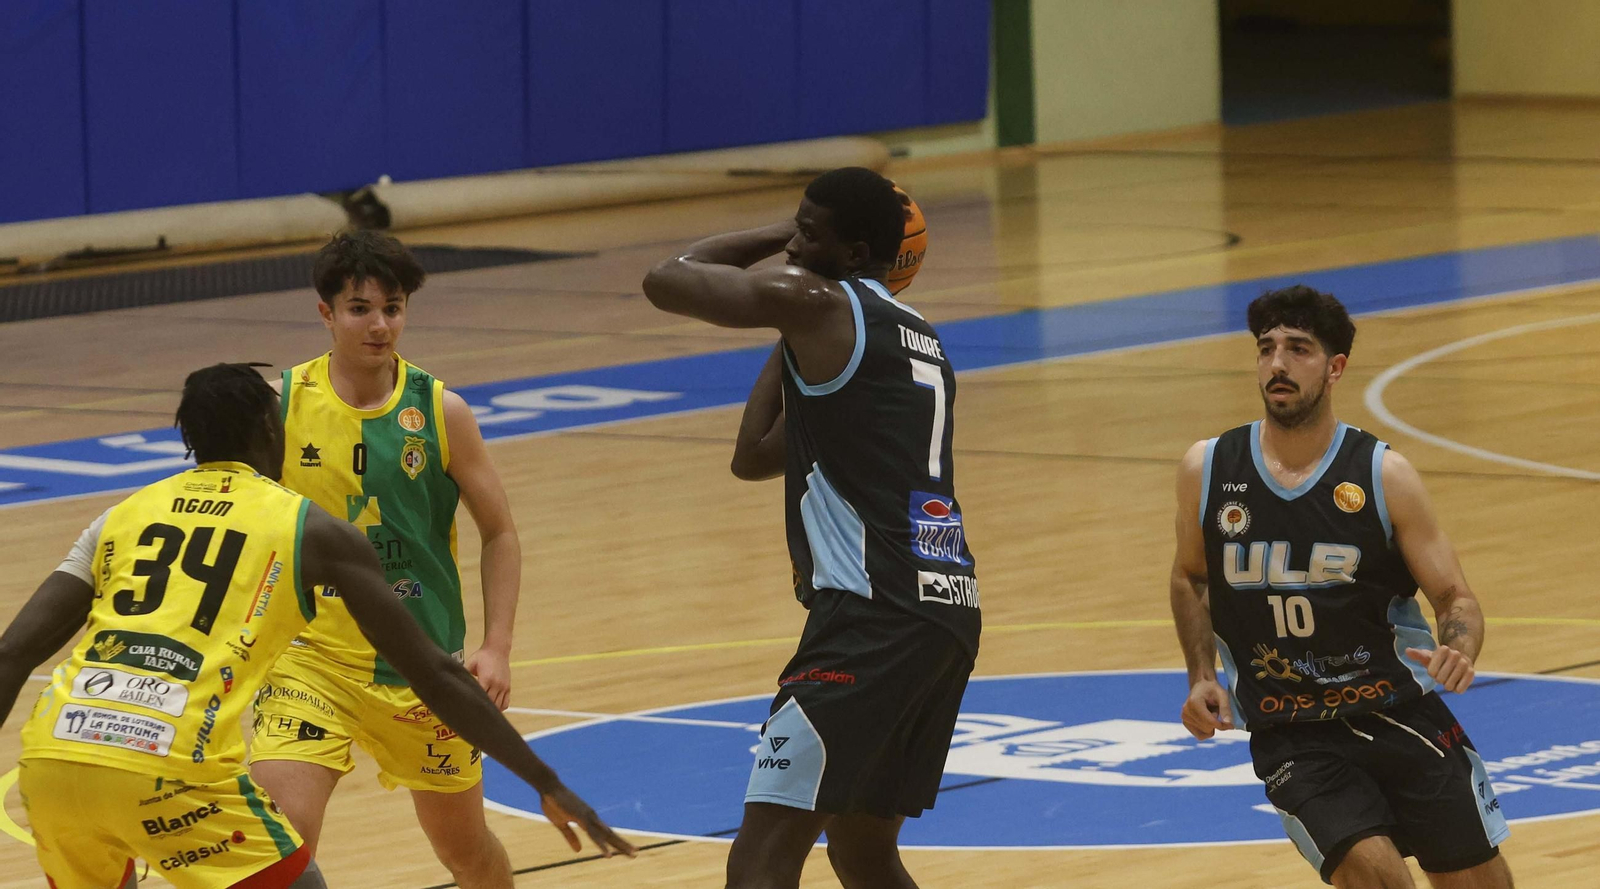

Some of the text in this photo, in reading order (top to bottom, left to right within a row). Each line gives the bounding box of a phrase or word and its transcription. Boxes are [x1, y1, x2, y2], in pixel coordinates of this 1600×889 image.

[898, 324, 945, 361] TOURE
[909, 358, 946, 482] 7
[353, 443, 367, 475] 0
[1222, 481, 1248, 493] vive
[112, 522, 248, 636] 34
[1224, 541, 1362, 590] ULB
[1267, 595, 1315, 638] 10
[158, 647, 199, 671] RURAL
[126, 677, 170, 696] ORO
[808, 668, 856, 685] Galán
[90, 720, 159, 740] LA FORTUNA
[758, 756, 791, 770] vive
[142, 803, 223, 835] Blanca
[160, 839, 230, 871] cajasur
